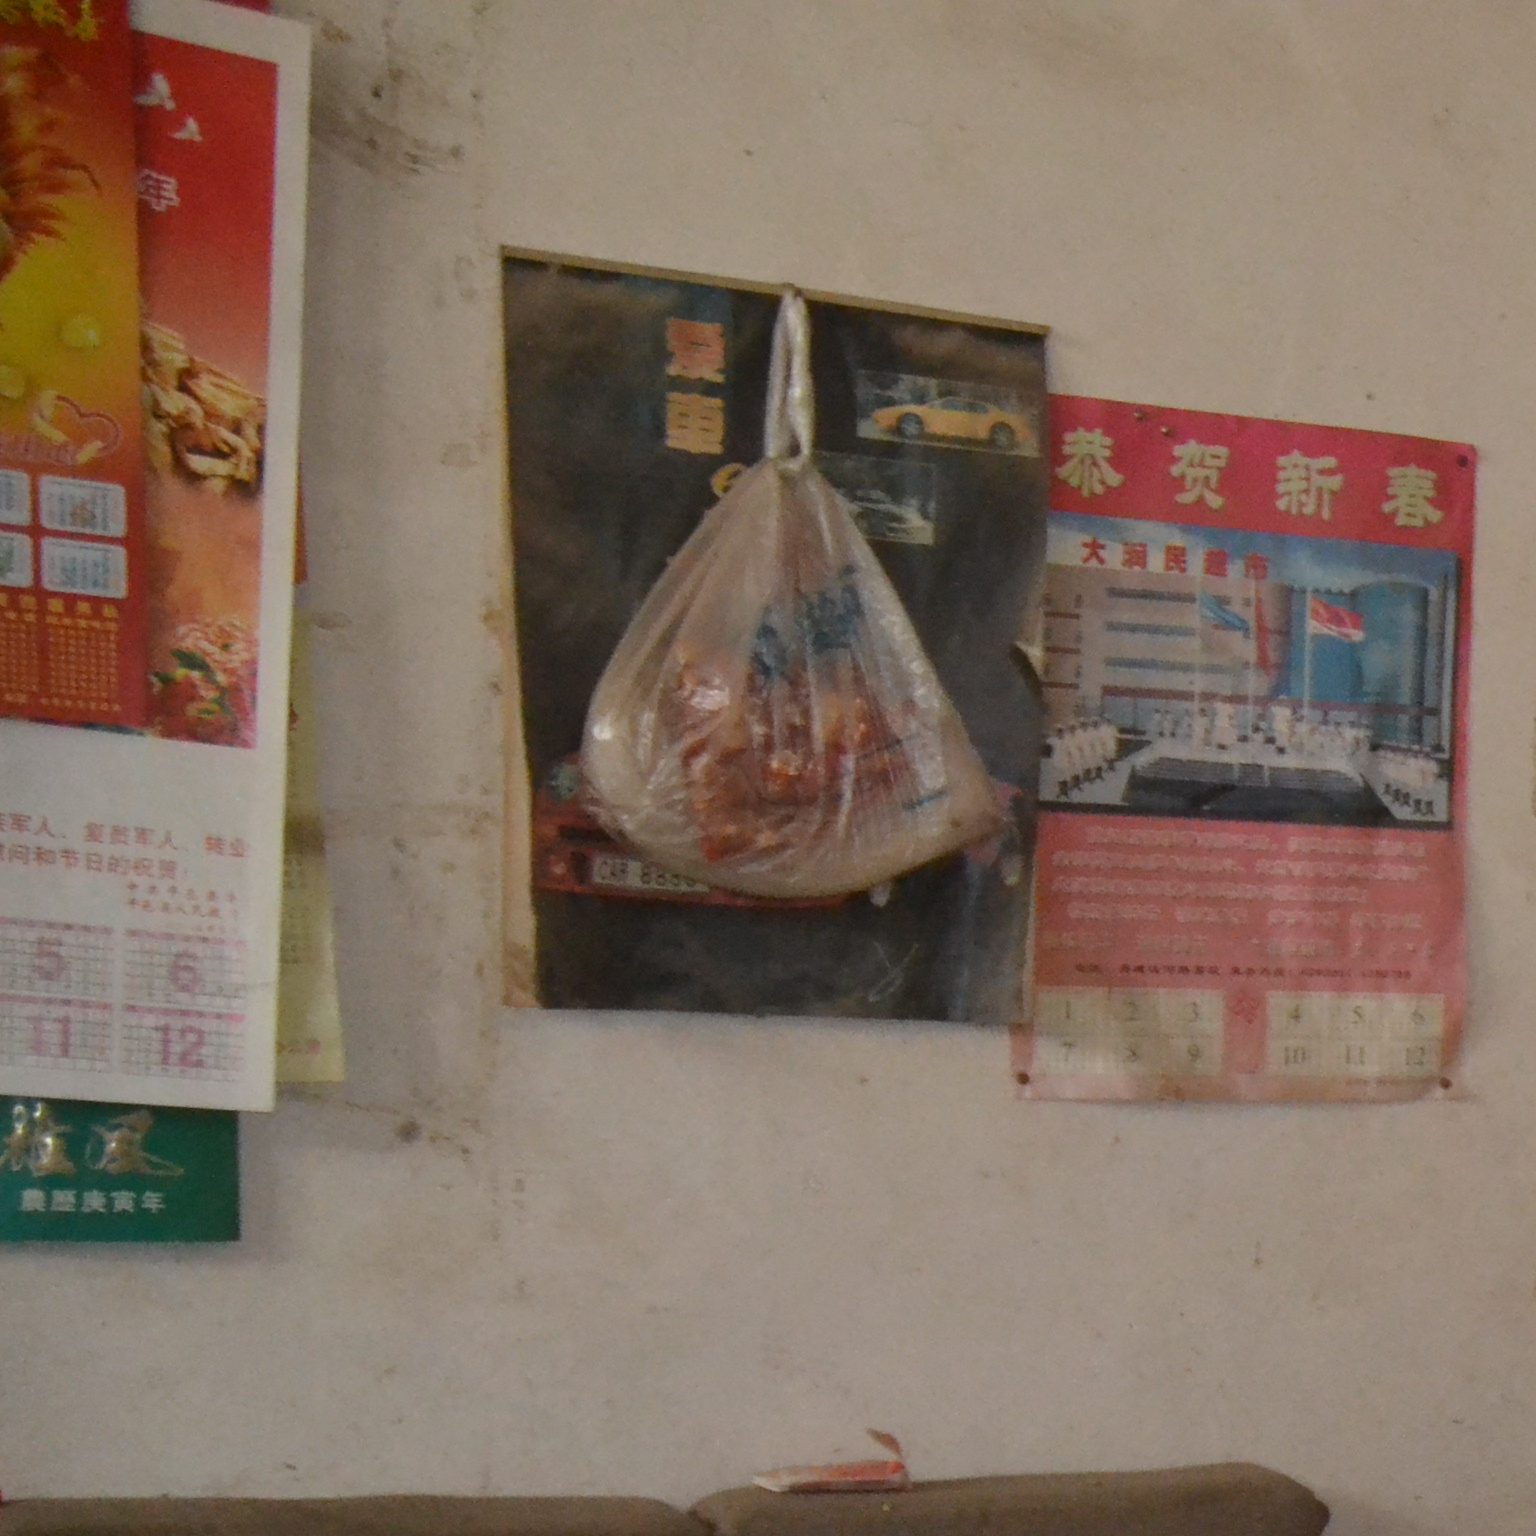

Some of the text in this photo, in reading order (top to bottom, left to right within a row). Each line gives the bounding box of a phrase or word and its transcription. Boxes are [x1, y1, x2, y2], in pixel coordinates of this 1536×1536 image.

[1055, 426, 1445, 528] 恭贺新春
[156, 1023, 206, 1069] 12
